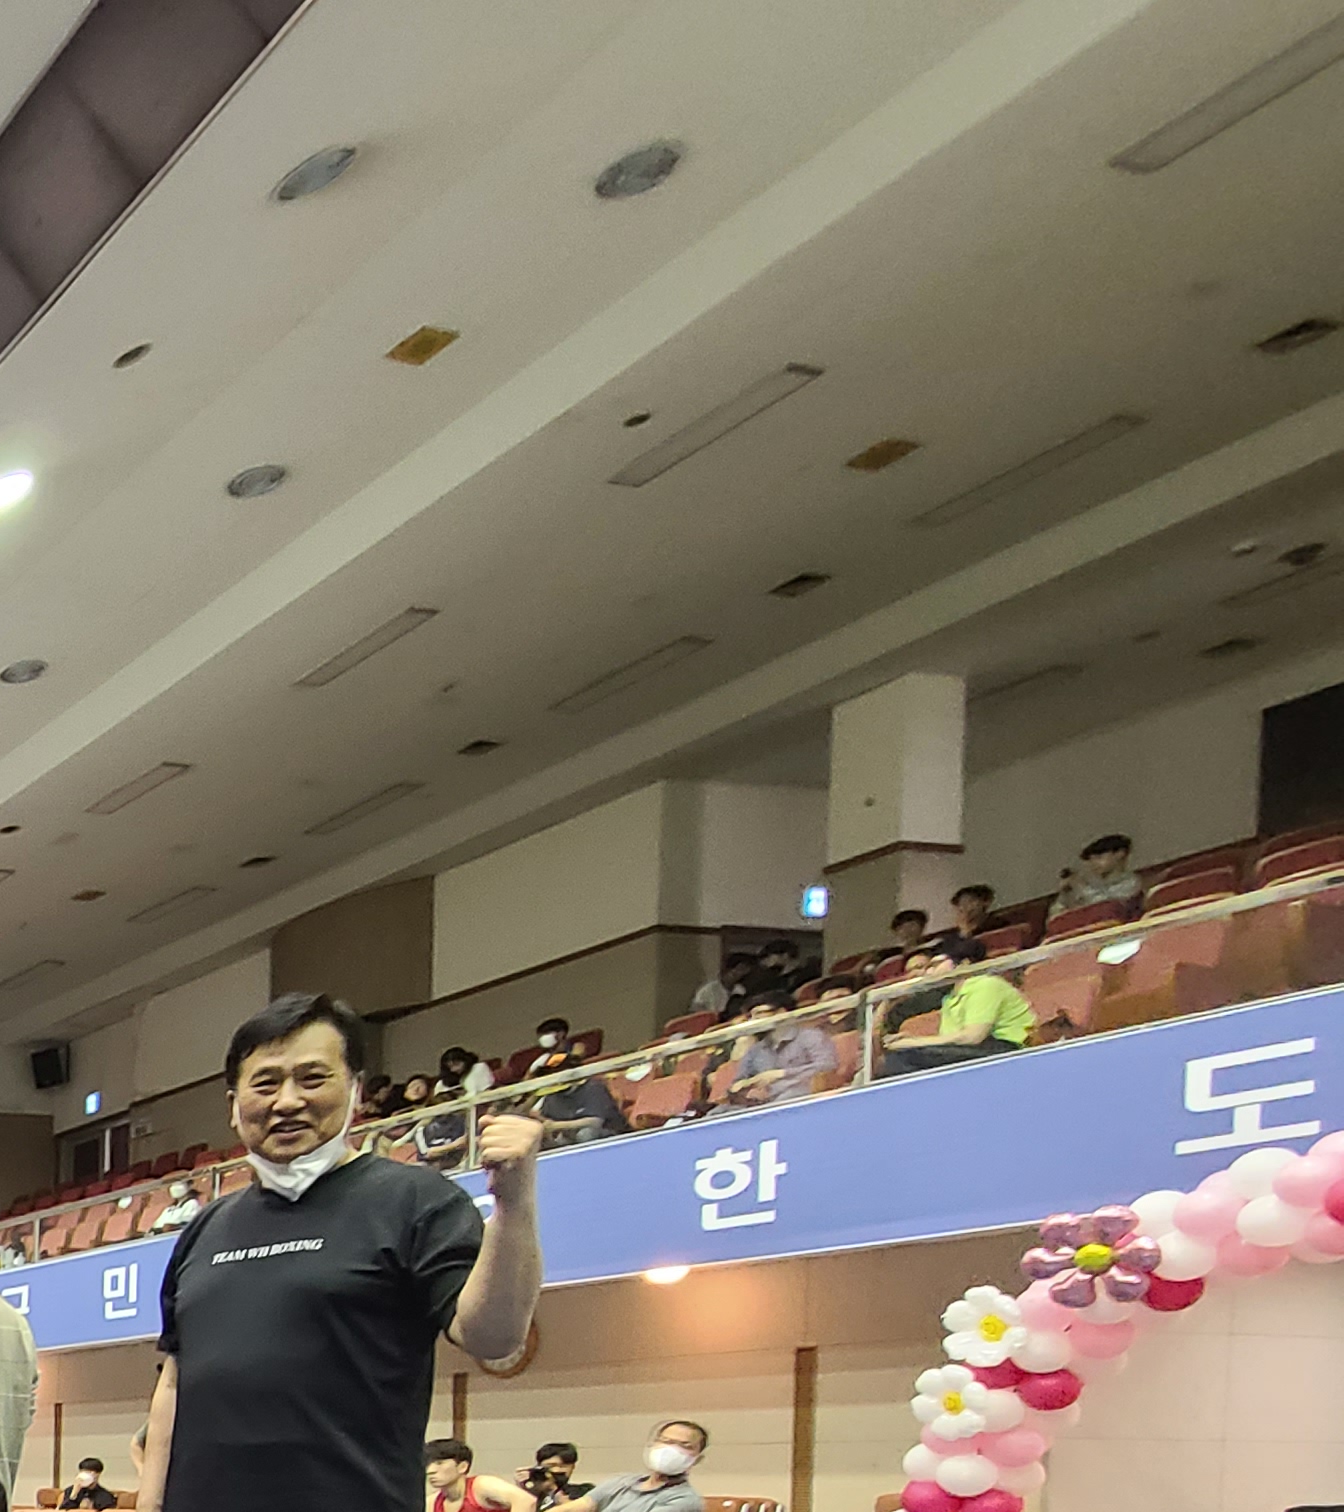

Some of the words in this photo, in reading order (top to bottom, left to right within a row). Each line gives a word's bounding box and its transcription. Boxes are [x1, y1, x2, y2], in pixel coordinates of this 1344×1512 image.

[1174, 1036, 1323, 1156] 도
[693, 1138, 789, 1232] 한
[211, 1248, 248, 1265] TEAM
[269, 1238, 325, 1257] BOXING
[102, 1262, 139, 1320] 민
